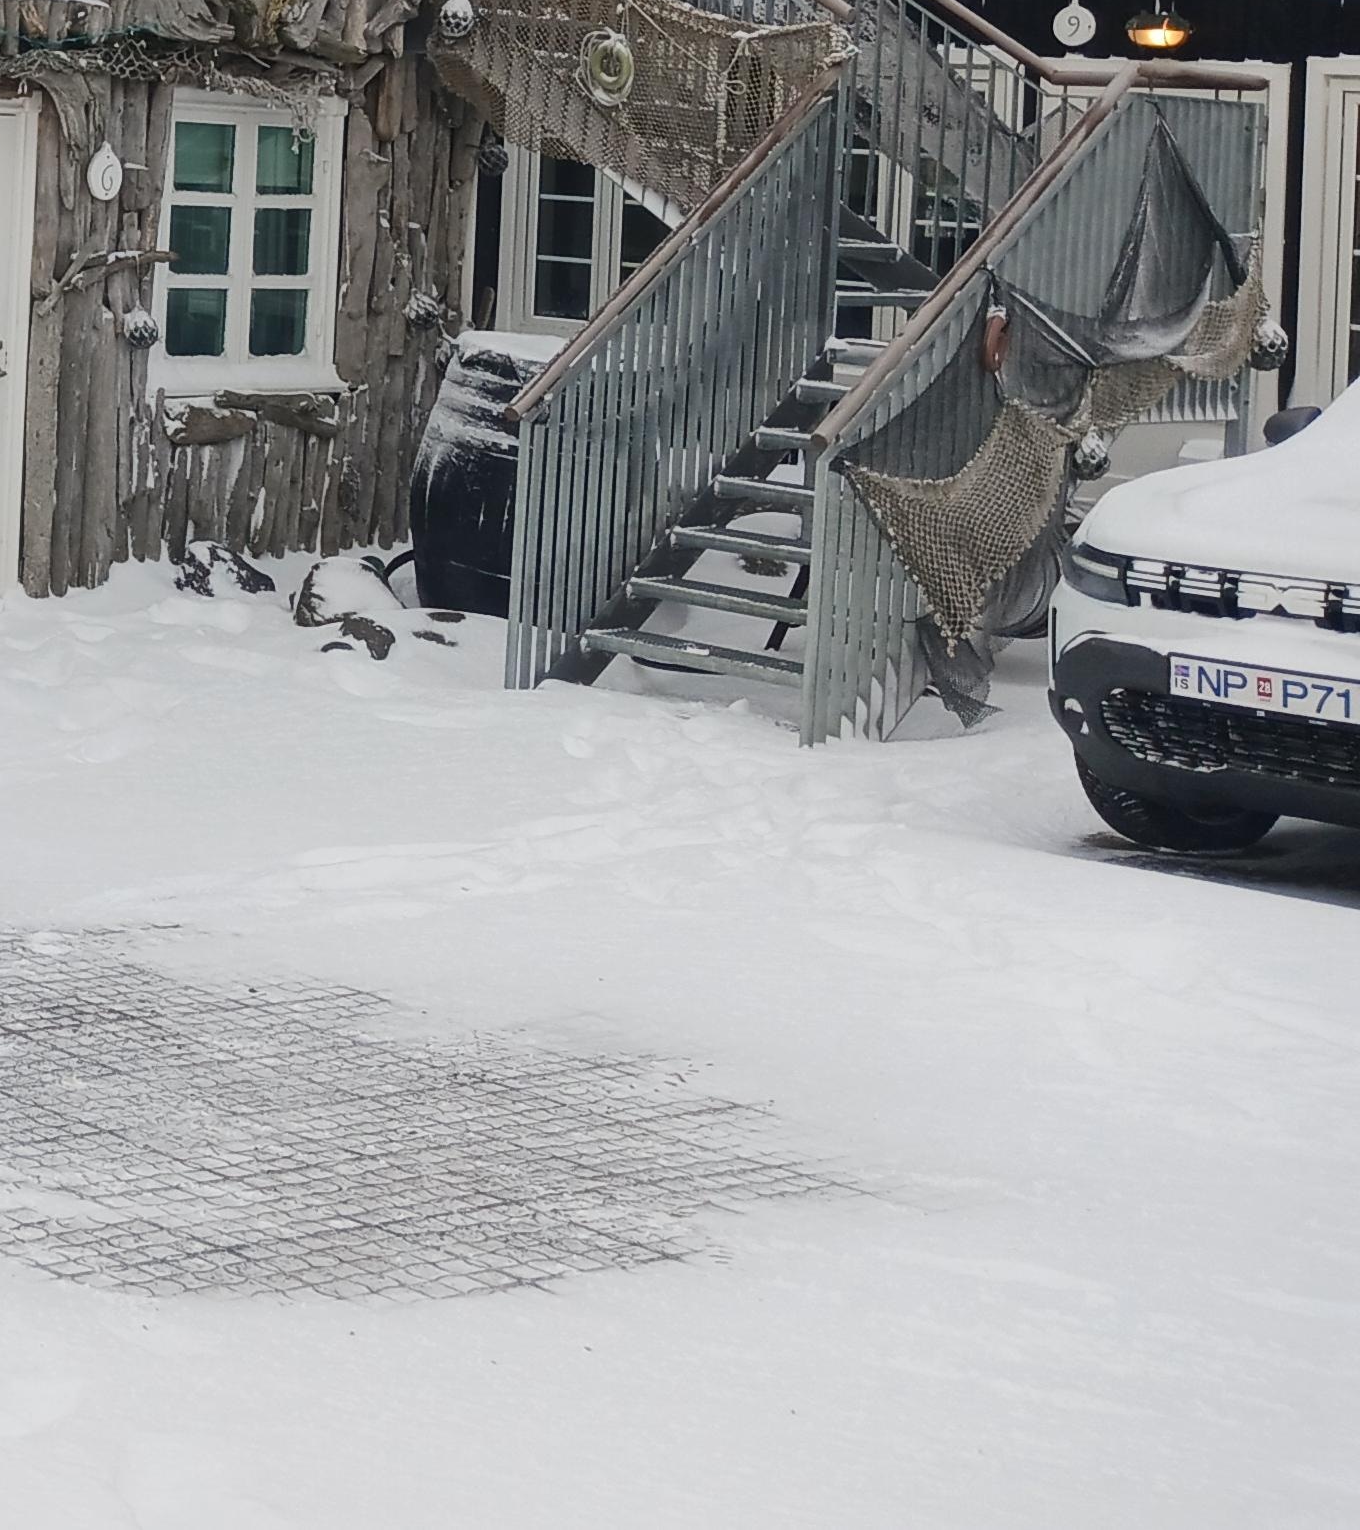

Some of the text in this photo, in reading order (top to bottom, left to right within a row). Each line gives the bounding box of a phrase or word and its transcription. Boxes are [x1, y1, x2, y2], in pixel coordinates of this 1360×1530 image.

[1067, 15, 1081, 38] 9
[101, 163, 114, 191] 6
[1174, 677, 1189, 690] IS
[1197, 666, 1351, 719] NP P71
